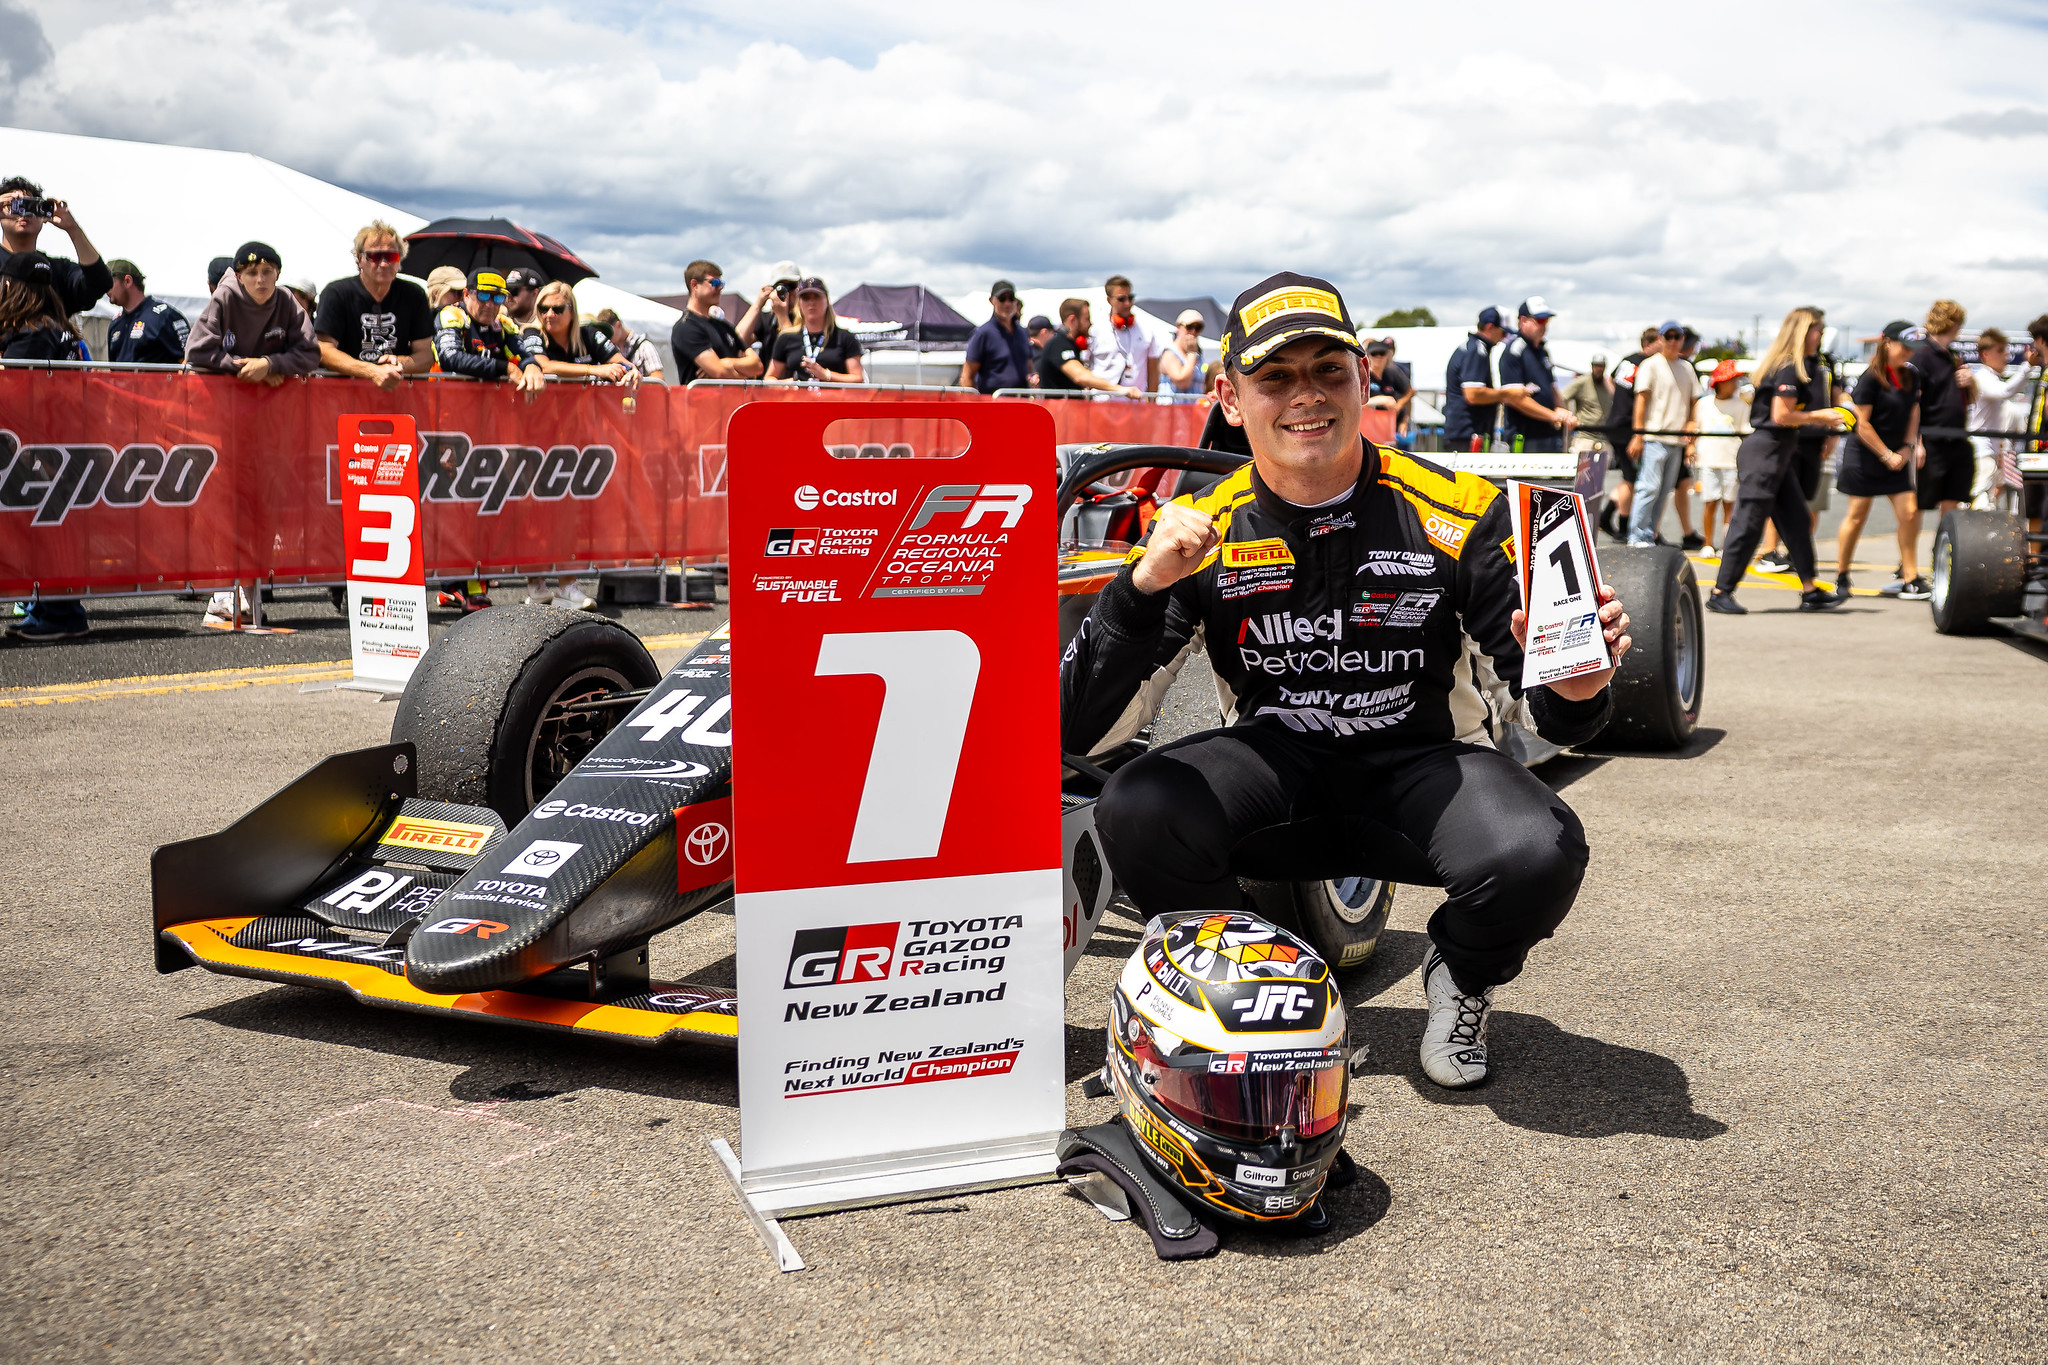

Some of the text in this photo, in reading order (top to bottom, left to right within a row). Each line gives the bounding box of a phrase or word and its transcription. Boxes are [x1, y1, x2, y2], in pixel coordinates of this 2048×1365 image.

[1246, 291, 1336, 327] PIRELLI
[822, 488, 897, 507] Castrol
[908, 483, 1033, 531] FR
[351, 494, 416, 579] 3
[822, 528, 879, 537] TOYOTA
[900, 533, 1009, 546] FORMULA
[1425, 517, 1464, 545] OMP
[1531, 523, 1539, 547] ROUND
[766, 539, 816, 555] GR
[820, 537, 873, 546] GAZOO
[818, 546, 870, 557] Racing
[892, 546, 1002, 560] REGIONAL
[1232, 543, 1290, 562] PIRELLI
[1368, 550, 1435, 563] TONY QUINN
[886, 559, 994, 574] OCEANIA
[1254, 570, 1287, 578] Zealand
[1549, 540, 1581, 596] 1
[755, 579, 838, 591] SUSTAINABLE
[881, 573, 991, 585] TROPHY
[1219, 576, 1237, 585] GR
[781, 589, 842, 603] FUEL
[1222, 585, 1245, 594] Finding
[1222, 592, 1238, 600] Next
[1239, 587, 1257, 596] World
[388, 598, 417, 606] TOYOTA
[1553, 595, 1582, 607] RACE ONE
[361, 604, 384, 617] GR
[386, 612, 413, 621] Racing
[360, 620, 414, 632] New Zealand
[1237, 609, 1343, 644] Allied
[1544, 621, 1564, 630] Castrol
[1567, 612, 1596, 631] FR
[1239, 645, 1425, 675] Petroleum
[1538, 667, 1561, 676] Finding
[1279, 680, 1415, 710] TONY QUINN
[1359, 697, 1410, 716] FOUNDATION
[814, 629, 981, 864] 1
[563, 803, 659, 827] Castrol
[389, 822, 484, 849] PIRELLI
[473, 880, 547, 899] TOYOTA
[451, 892, 548, 910] Financial Services
[424, 918, 510, 940] GR
[908, 915, 1023, 937] TOYOTA
[903, 935, 1011, 957] GAZOO
[788, 946, 891, 986] GR
[899, 955, 1006, 977] Racing
[1147, 949, 1177, 986] Mobil
[1136, 981, 1152, 1000] P
[784, 981, 1007, 1023] New Zealand
[1153, 995, 1175, 1012] PENNY
[1150, 1003, 1172, 1021] HOMES
[784, 1038, 1024, 1074] Finding New Zealand's
[1253, 1049, 1341, 1060] TOYOTA GAZOO Racing
[784, 1057, 1011, 1092] Next World Champion
[1209, 1060, 1245, 1073] GR
[1251, 1059, 1334, 1072] New Zealand
[1243, 1168, 1316, 1183] Giltrap Group
